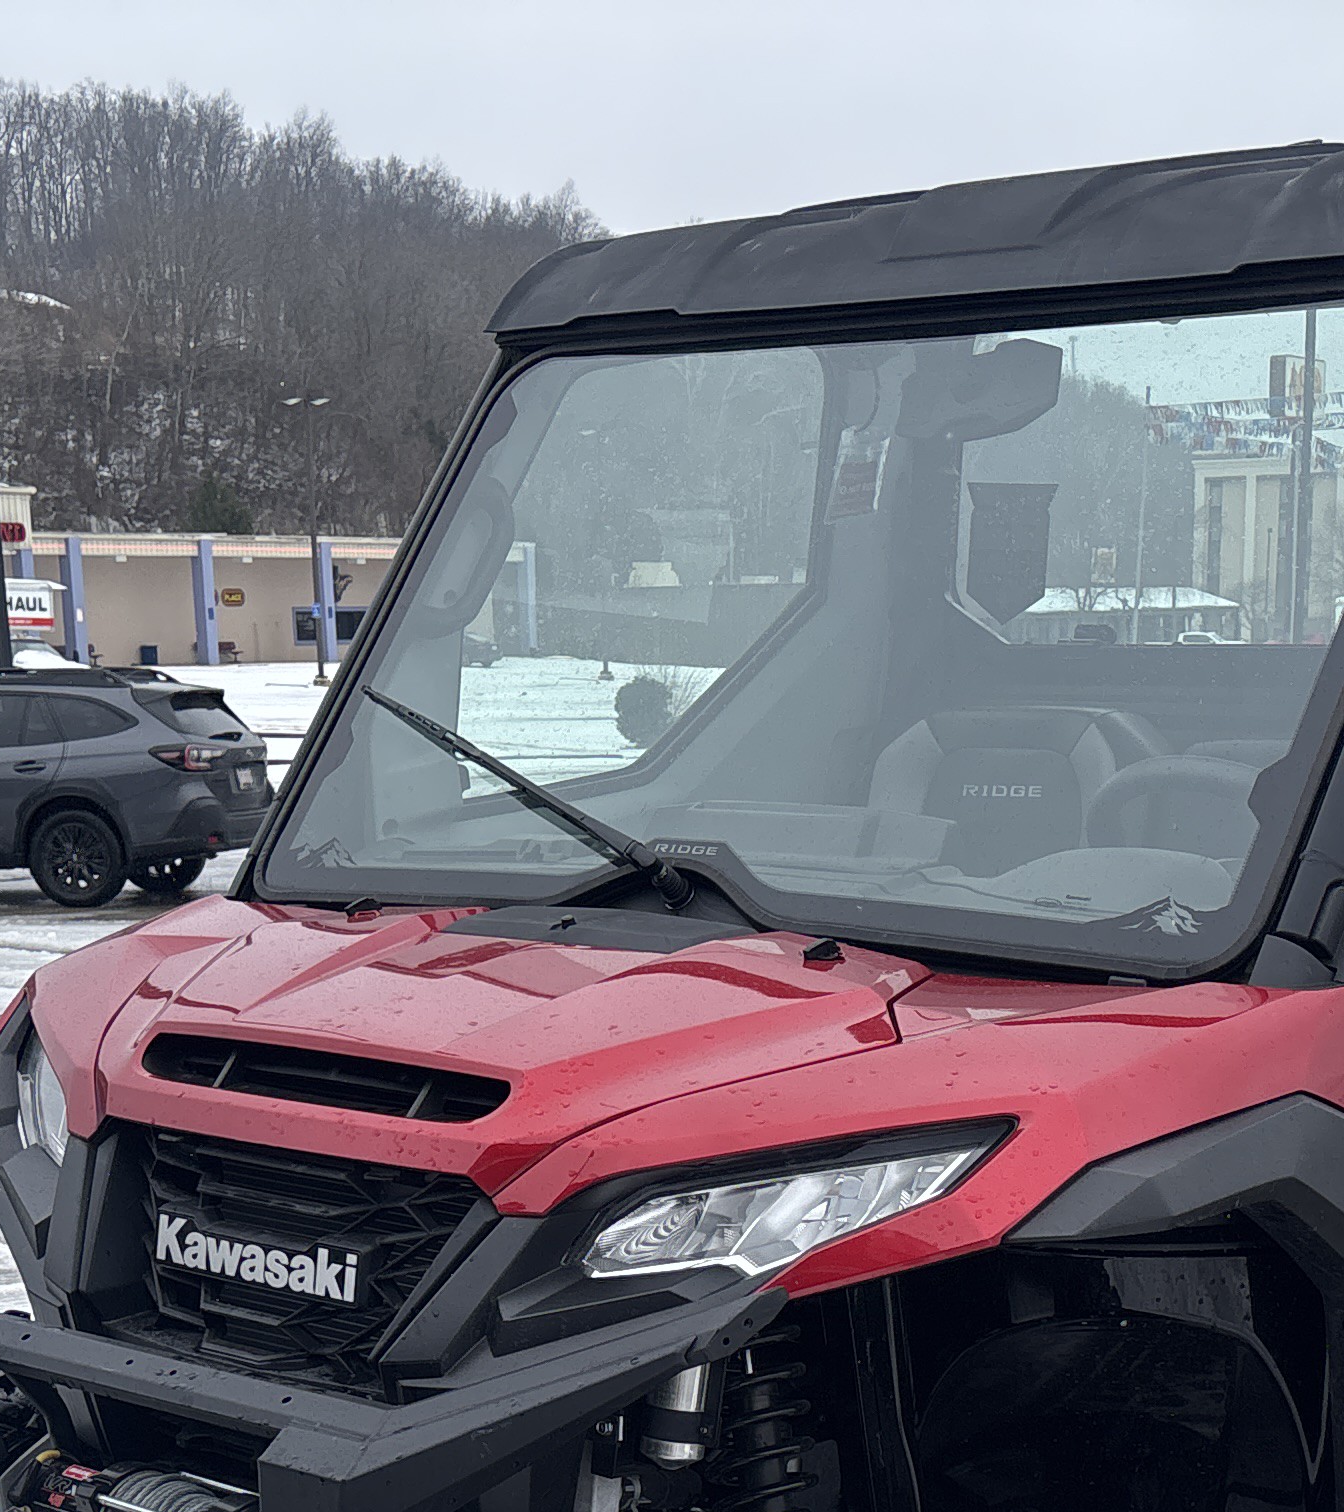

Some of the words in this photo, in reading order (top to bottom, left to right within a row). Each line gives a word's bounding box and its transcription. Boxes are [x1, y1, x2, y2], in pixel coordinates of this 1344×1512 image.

[962, 784, 1042, 798] RIDGE
[655, 843, 719, 856] RIDGE
[156, 1213, 358, 1303] Kawasaki
